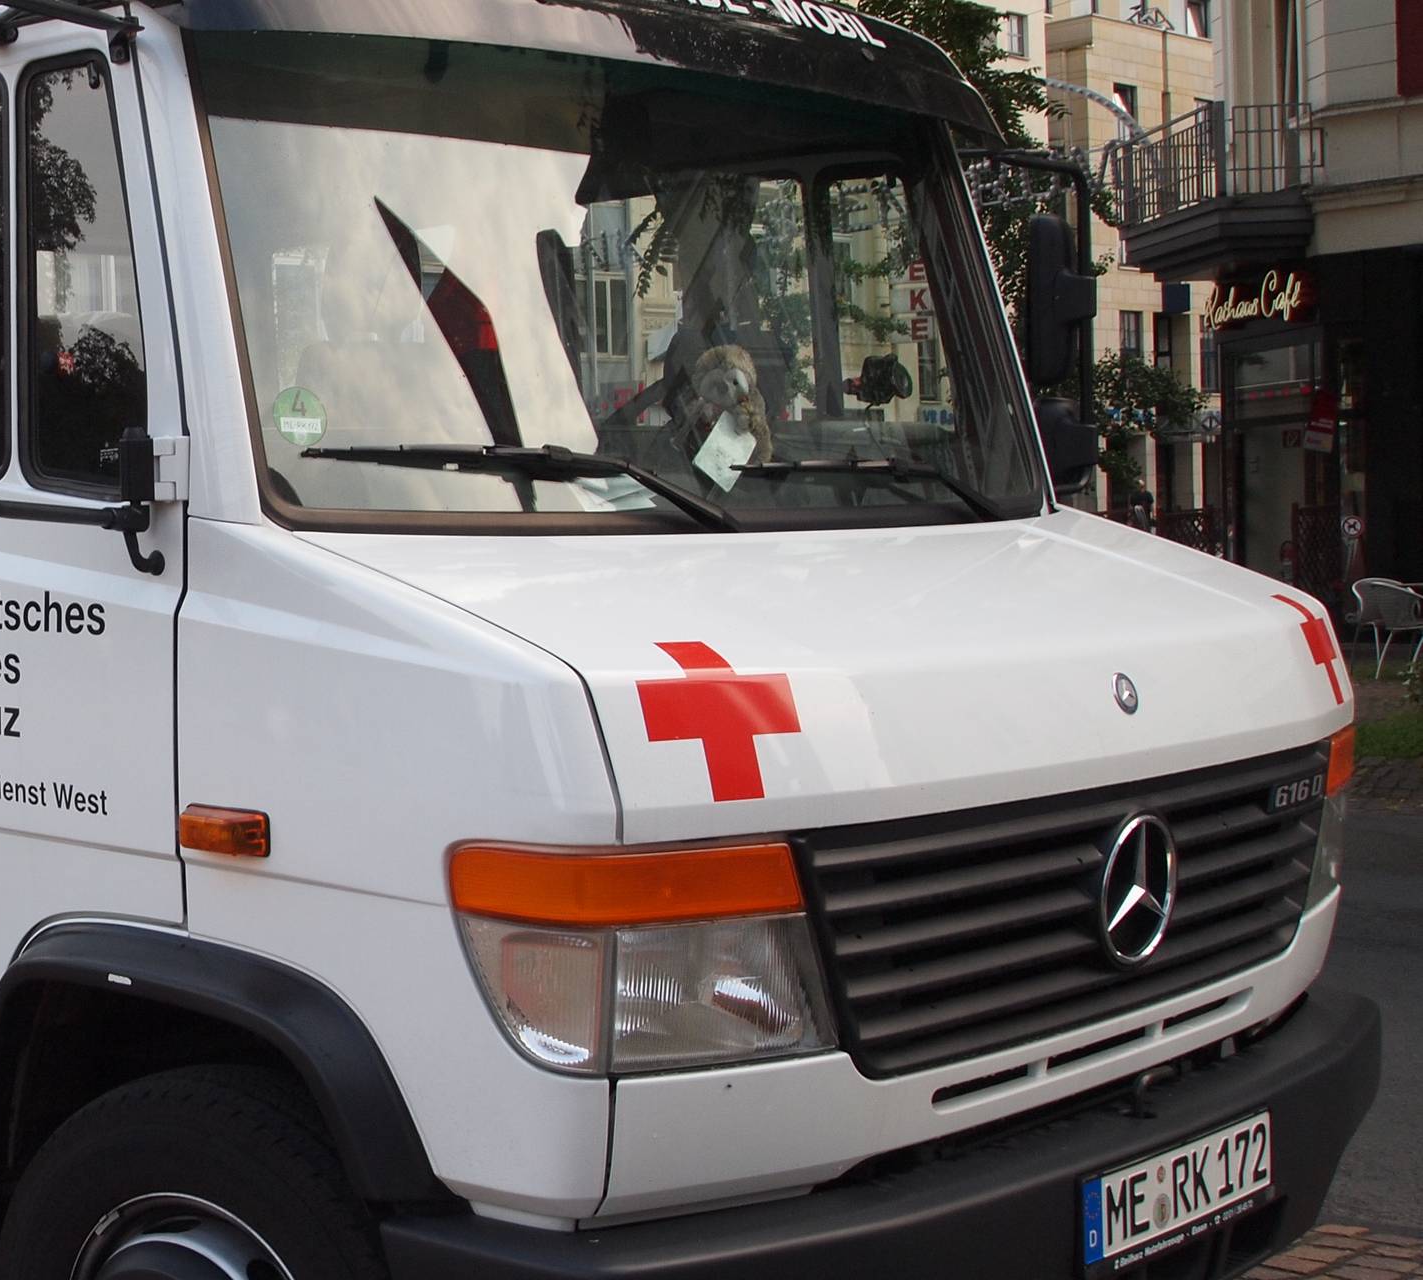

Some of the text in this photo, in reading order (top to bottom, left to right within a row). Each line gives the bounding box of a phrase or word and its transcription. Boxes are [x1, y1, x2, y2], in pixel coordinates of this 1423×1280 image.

[292, 389, 307, 417] 4
[52, 782, 108, 816] West
[1275, 779, 1310, 808] 616
[1105, 1122, 1267, 1247] ME RK 172
[1089, 1229, 1098, 1248] D
